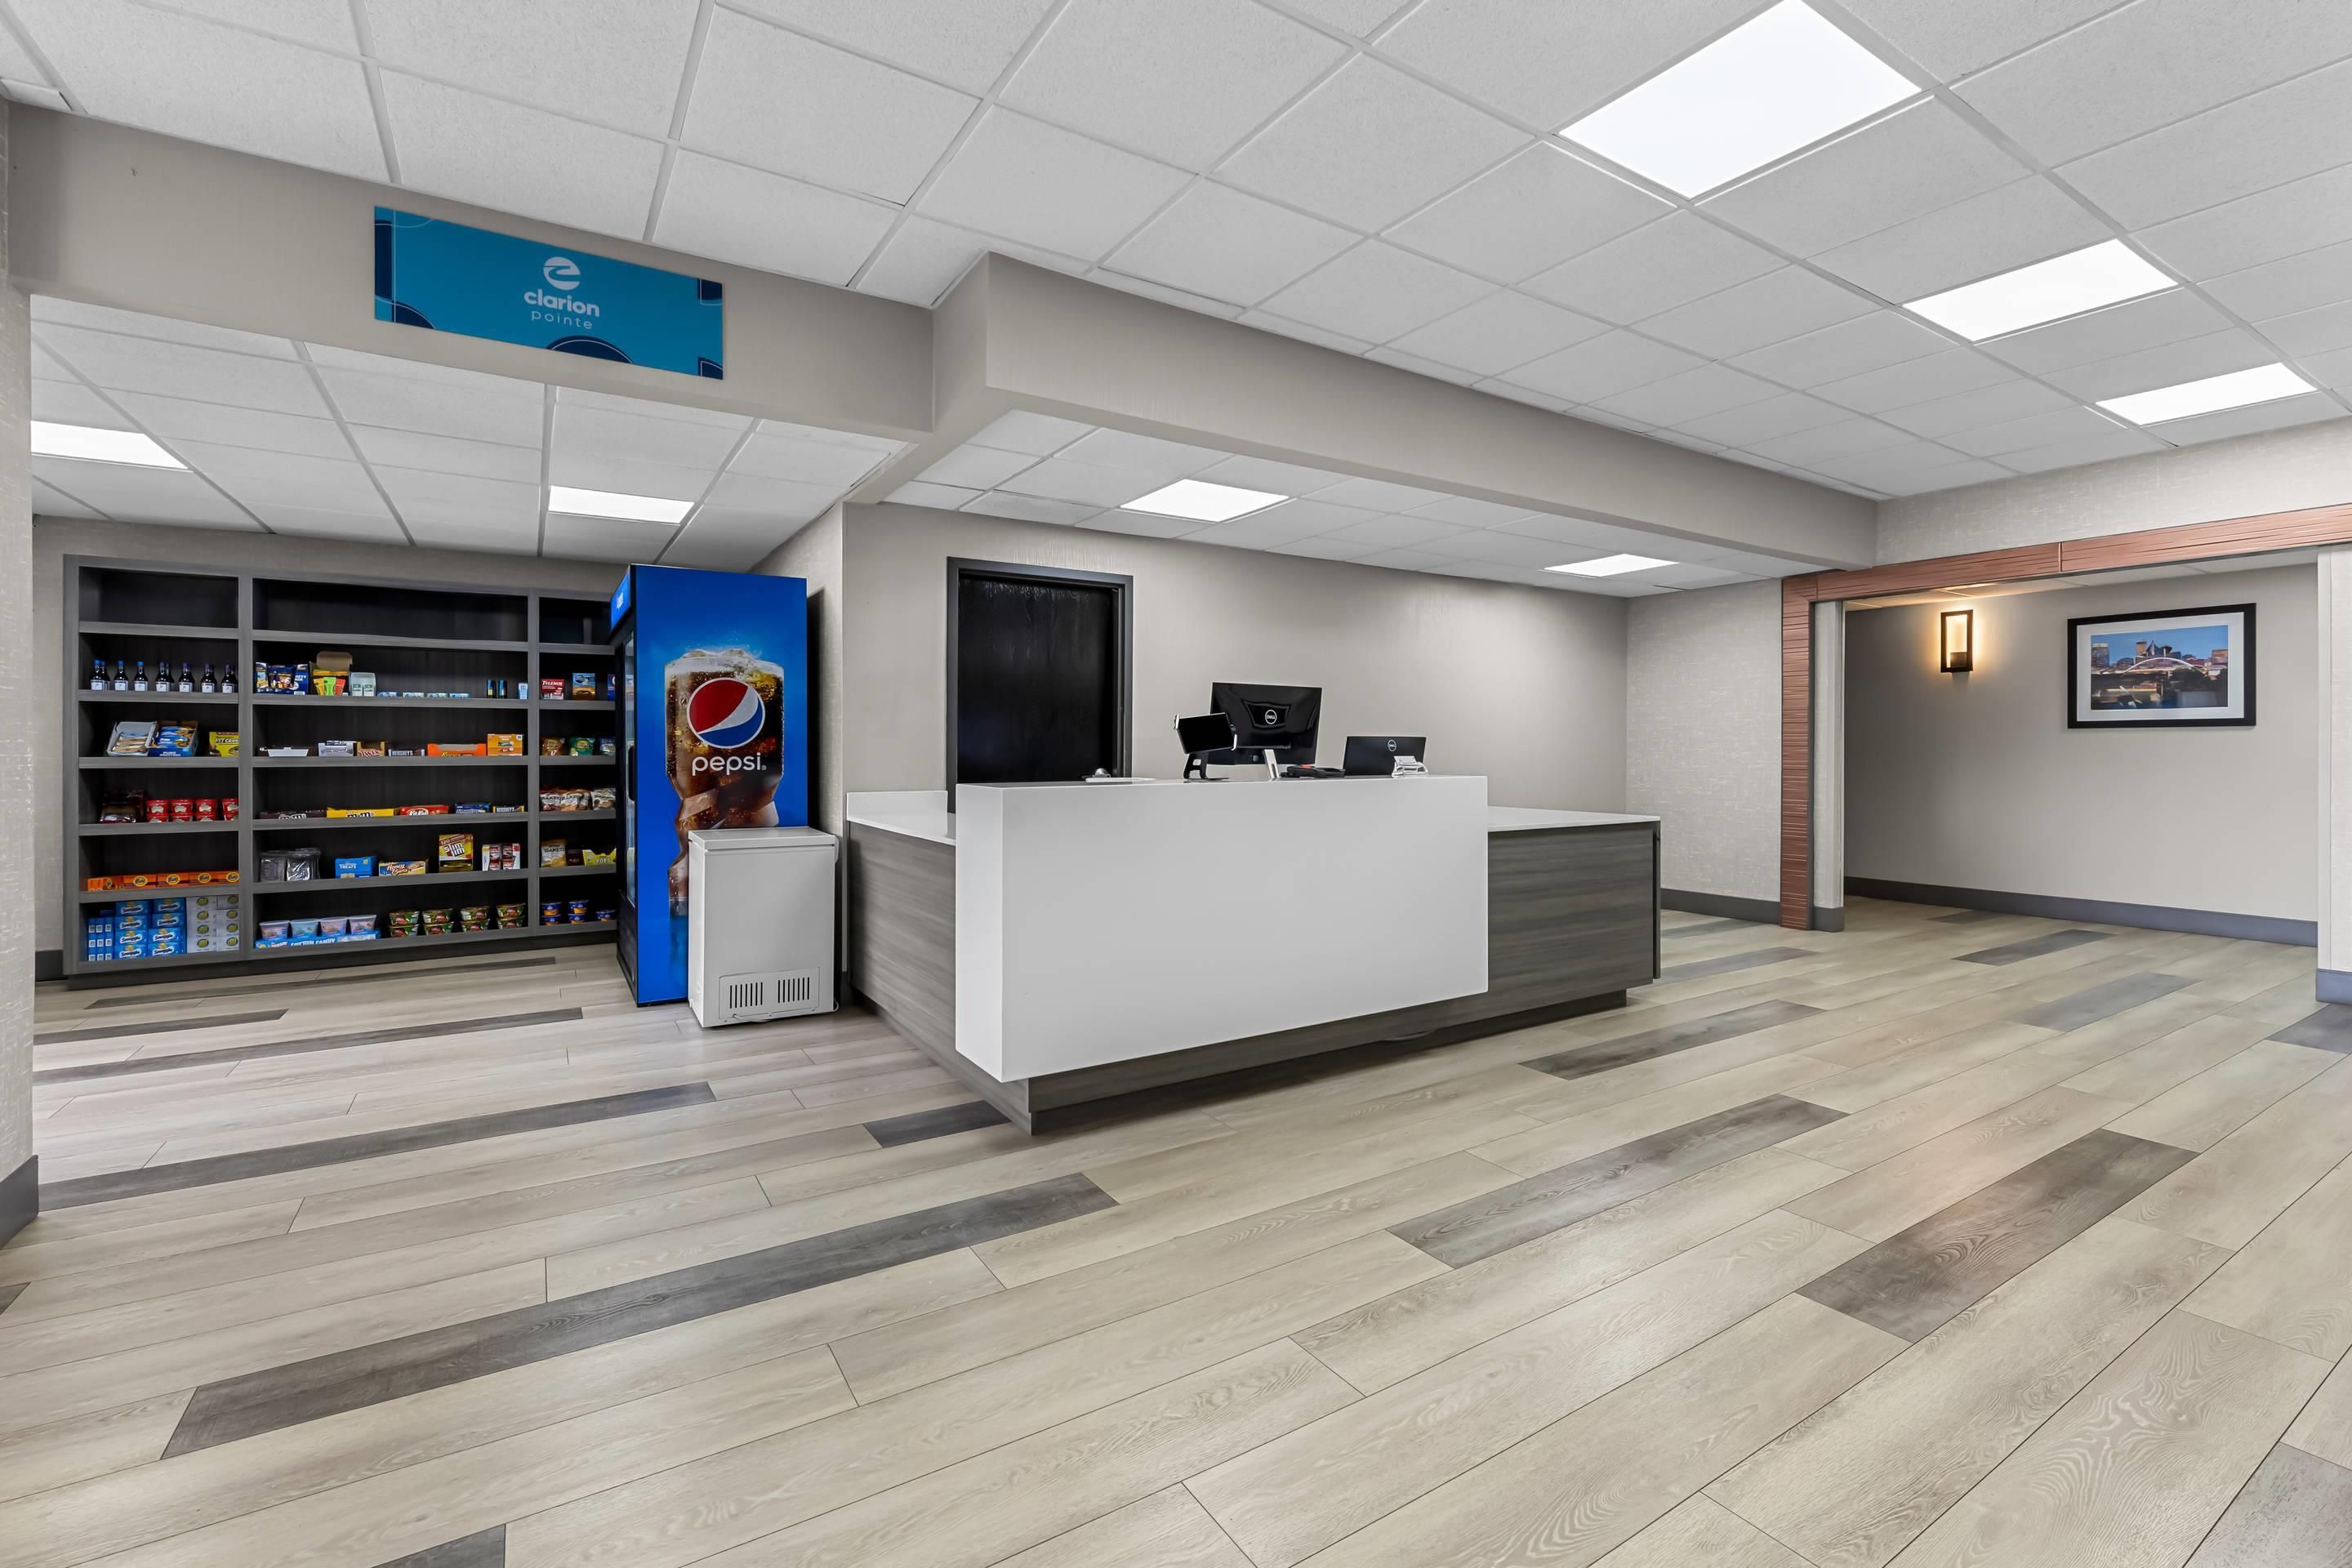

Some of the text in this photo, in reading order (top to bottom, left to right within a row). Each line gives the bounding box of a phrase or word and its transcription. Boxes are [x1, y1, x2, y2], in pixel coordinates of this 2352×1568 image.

[523, 288, 600, 318] clarion
[531, 310, 593, 330] pointe
[692, 751, 762, 777] pepsi
